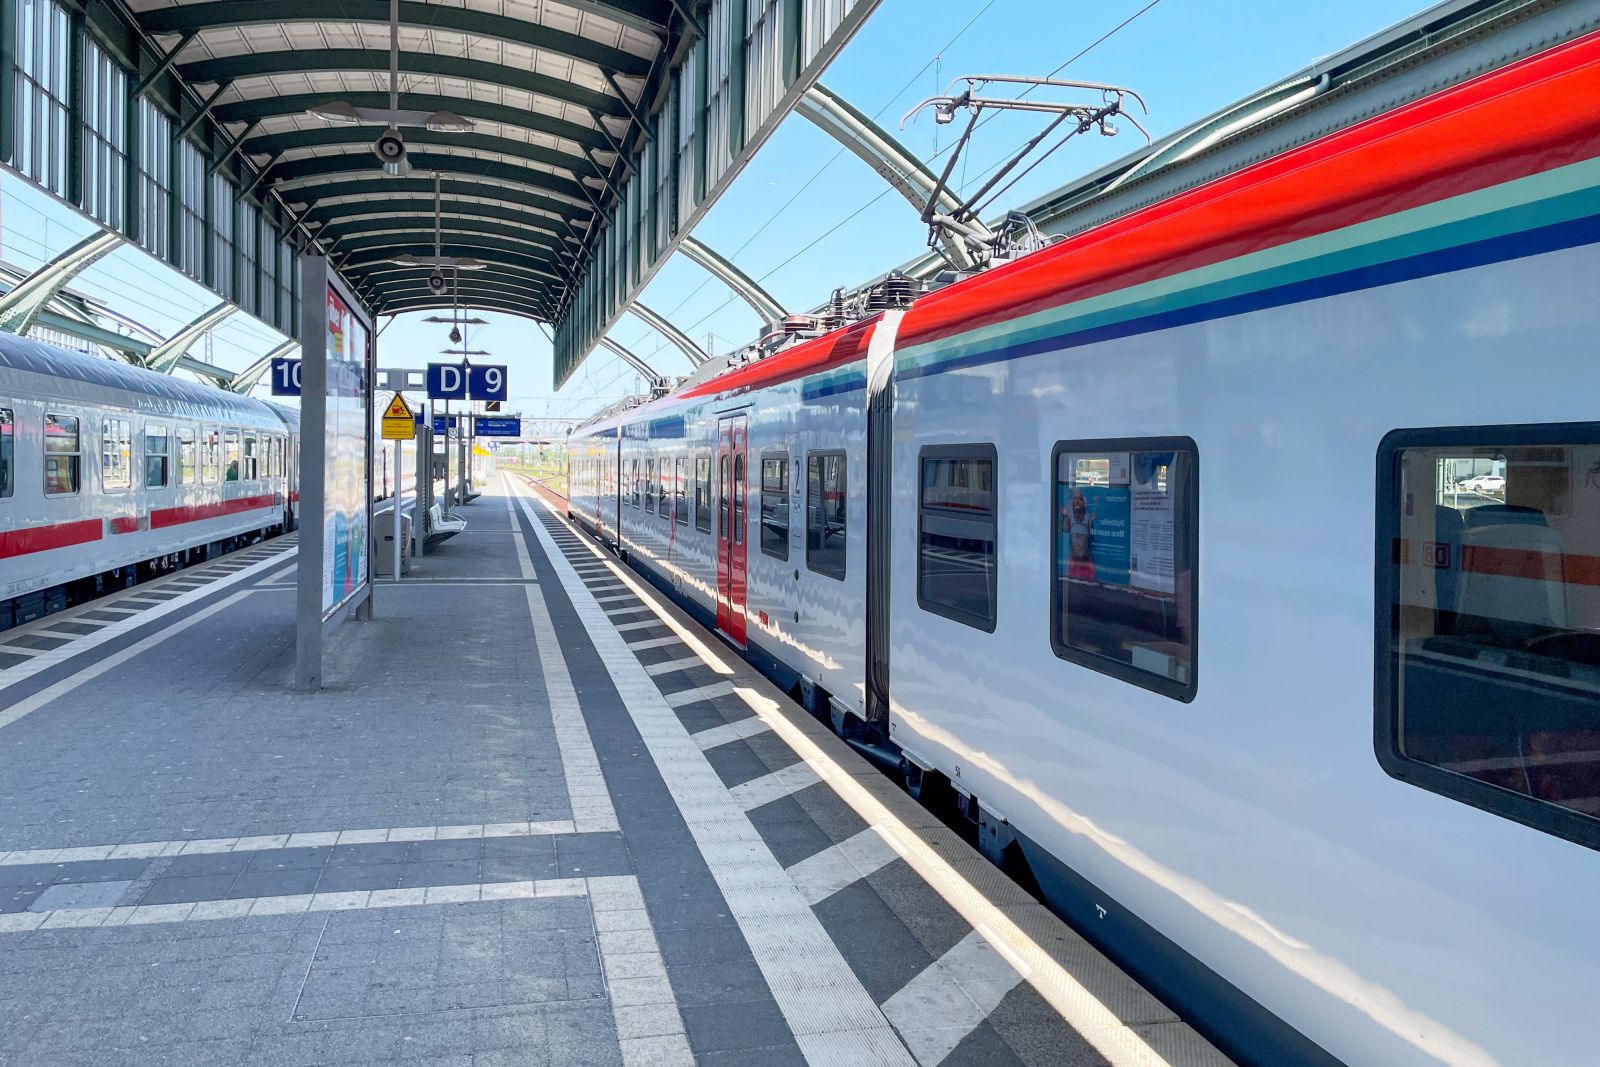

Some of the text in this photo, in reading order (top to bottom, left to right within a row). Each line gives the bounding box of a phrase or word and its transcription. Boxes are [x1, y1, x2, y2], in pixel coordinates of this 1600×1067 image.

[440, 366, 461, 392] D
[485, 367, 502, 393] 9
[795, 460, 800, 494] 2
